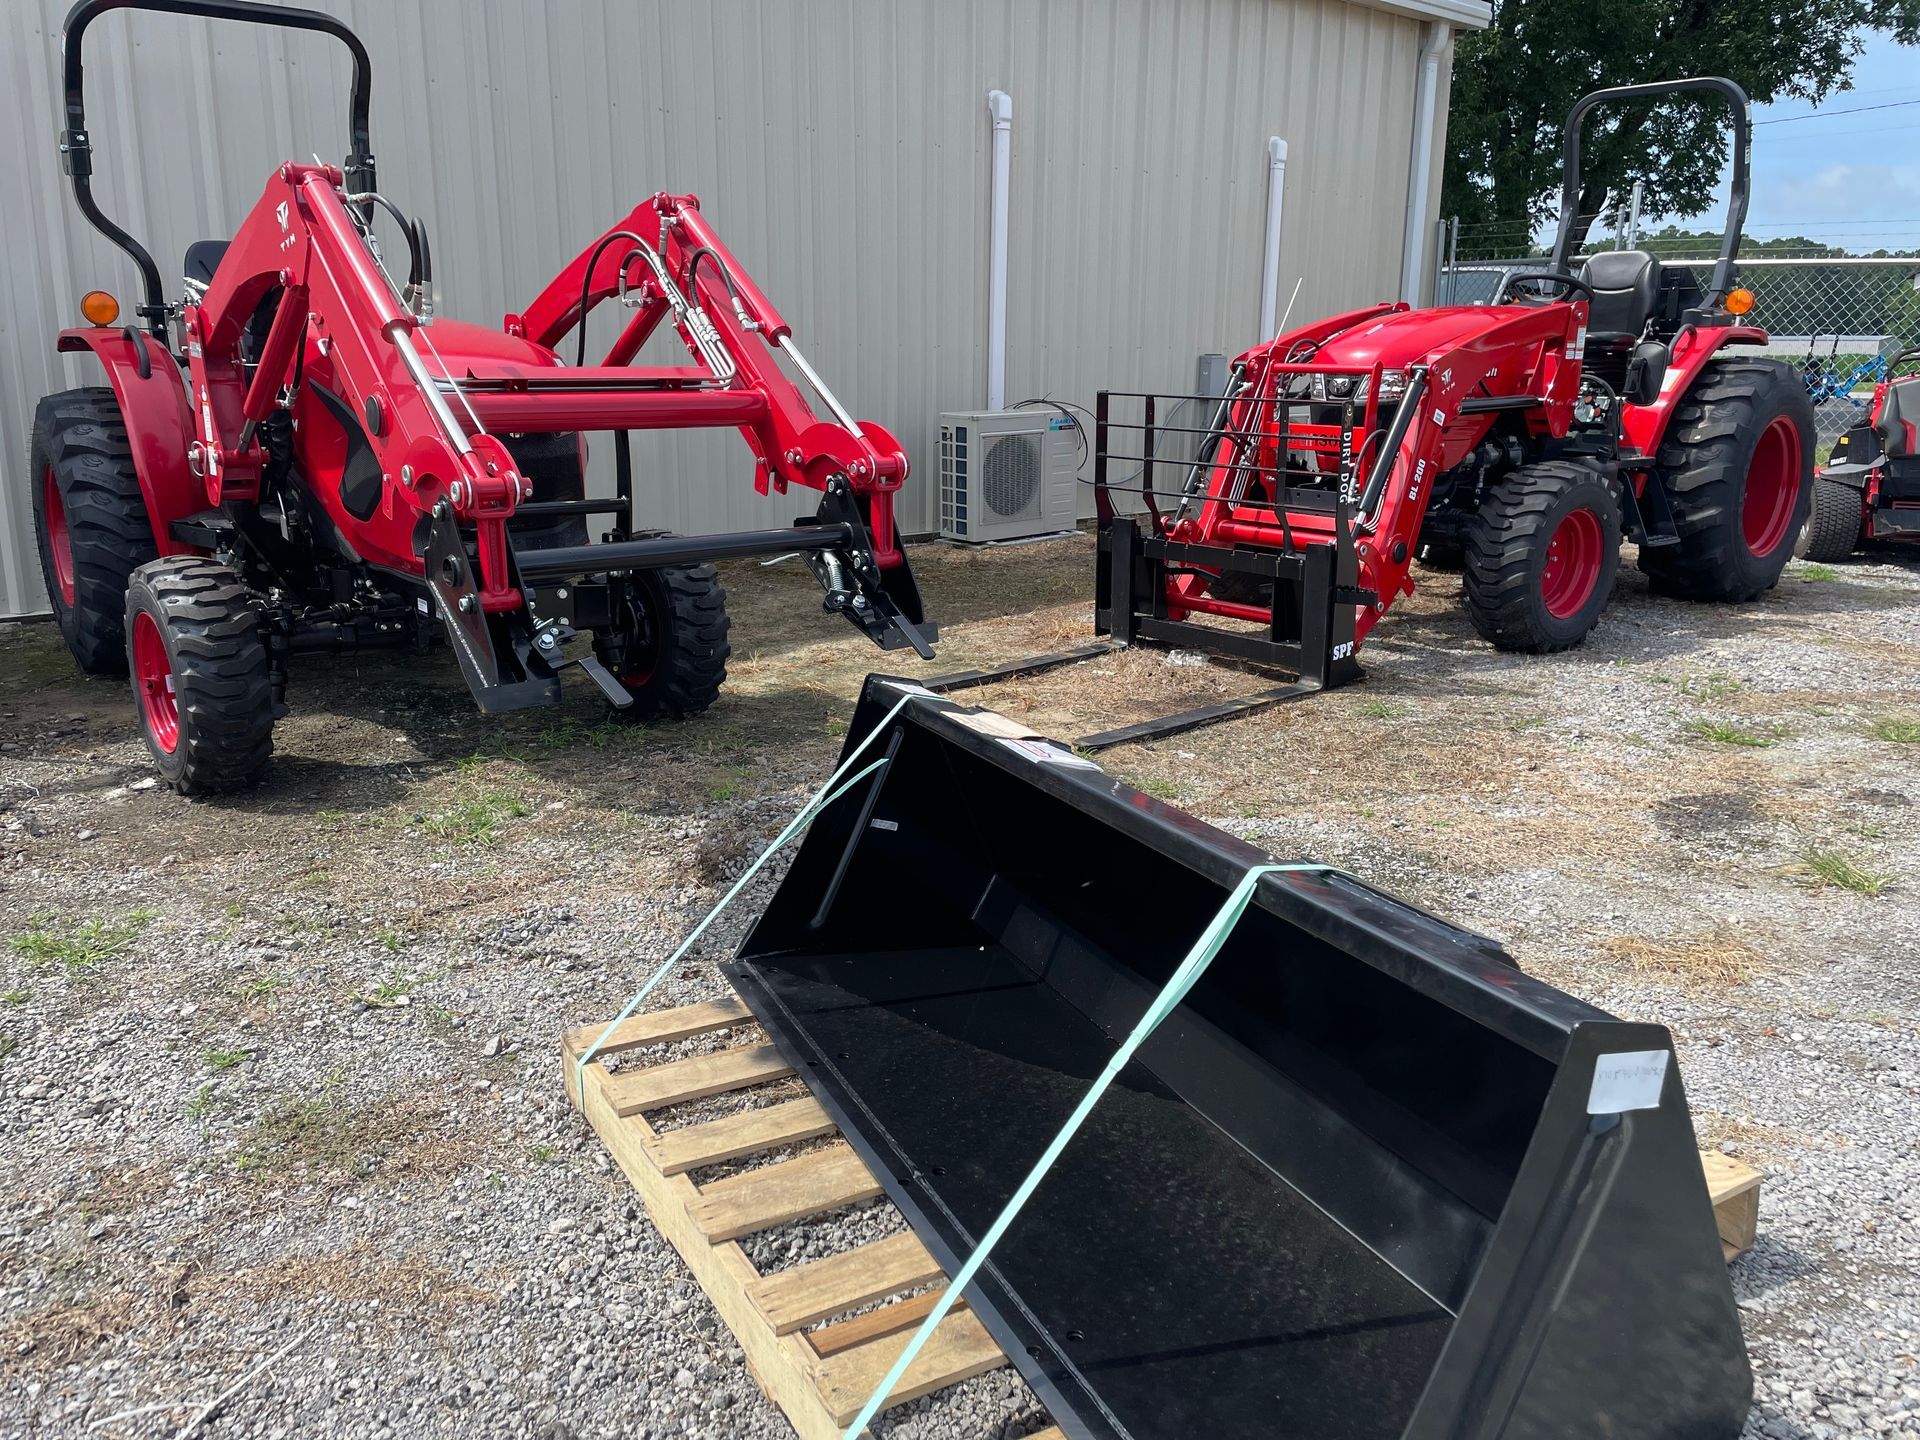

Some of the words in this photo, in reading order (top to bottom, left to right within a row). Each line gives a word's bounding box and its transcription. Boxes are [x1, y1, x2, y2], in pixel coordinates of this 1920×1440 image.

[280, 233, 296, 252] TYM
[1441, 381, 1456, 395] TYM
[1342, 431, 1352, 465] DIRT
[1339, 472, 1350, 504] DOG
[1408, 485, 1419, 501] BL
[1414, 458, 1426, 484] 200
[1332, 640, 1354, 661] SPF
